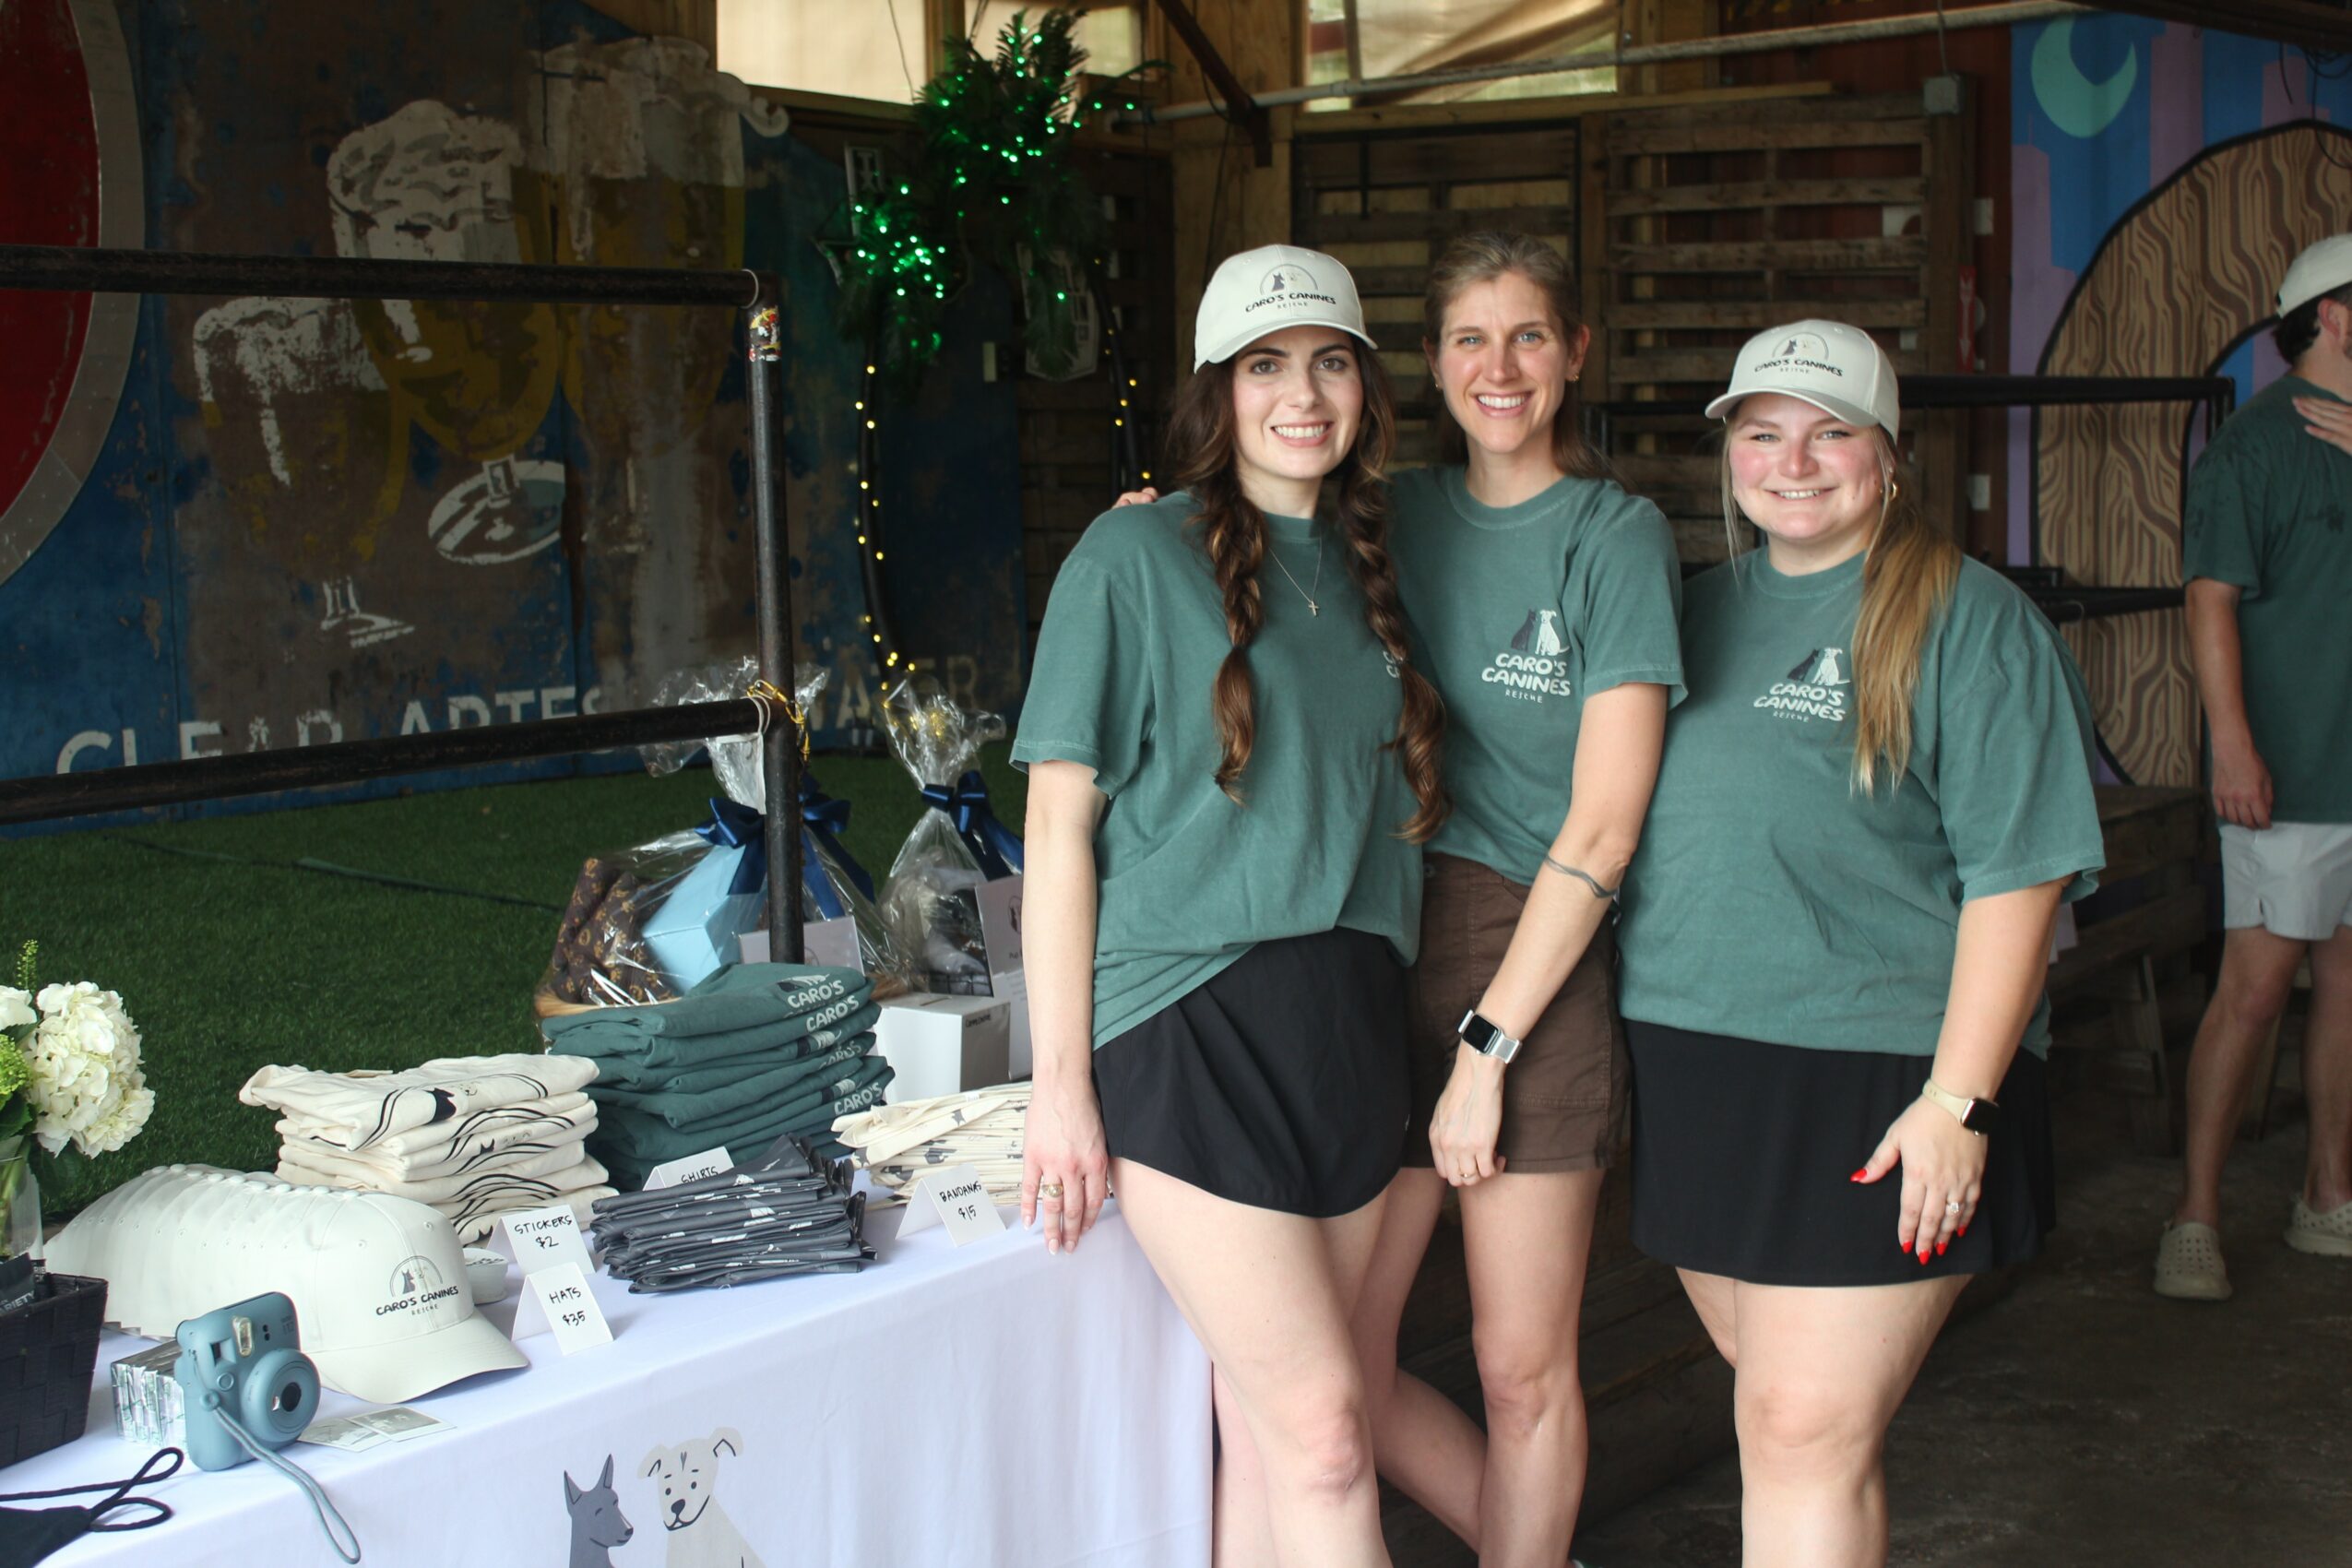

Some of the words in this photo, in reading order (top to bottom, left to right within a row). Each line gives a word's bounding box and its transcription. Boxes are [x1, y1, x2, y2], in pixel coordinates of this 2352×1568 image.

[1245, 294, 1285, 313] CARO'S
[1289, 292, 1336, 305] CANINES
[1794, 359, 1843, 376] CANINES
[1495, 653, 1567, 678] CARO'S
[1481, 667, 1571, 696] CANINES
[1505, 688, 1543, 704] RESCUE
[1769, 683, 1845, 707] CARO'S
[1753, 695, 1846, 721] CANINES
[787, 980, 845, 1008] CARO'S
[806, 994, 860, 1032] CARO'S
[834, 1082, 883, 1116] CARO'S
[681, 1166, 719, 1183] SHIRTS
[514, 1215, 573, 1235] STICKERS
[535, 1235, 560, 1250] $2
[375, 1297, 418, 1316] CARO'S
[421, 1286, 459, 1303] CANINES
[549, 1287, 581, 1304] HATS
[562, 1311, 587, 1326] $35
